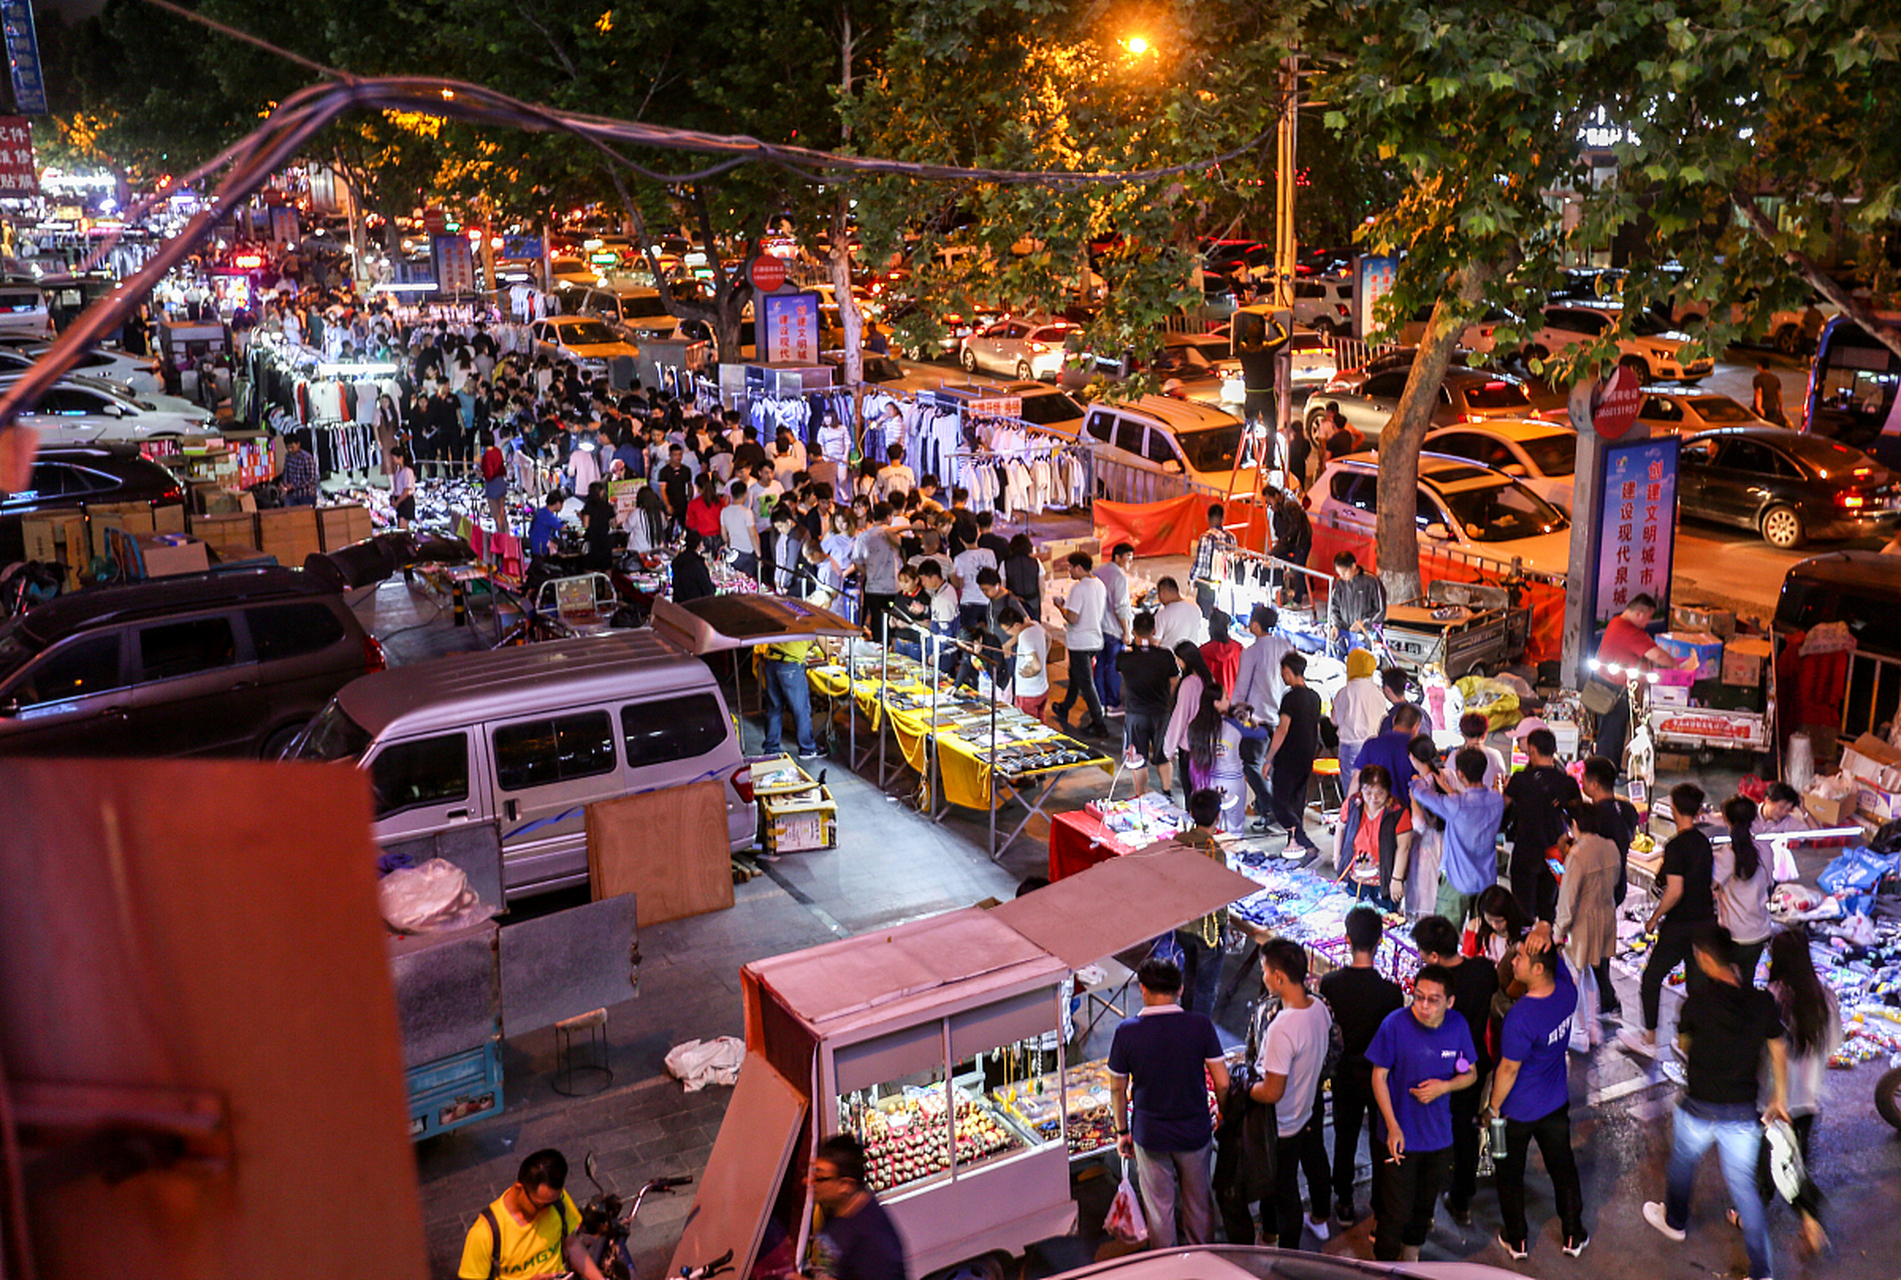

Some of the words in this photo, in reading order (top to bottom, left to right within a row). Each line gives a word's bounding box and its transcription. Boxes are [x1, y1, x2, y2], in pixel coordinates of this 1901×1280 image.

[778, 314, 790, 362] 建设现代
[1612, 481, 1636, 606] 建设现代泉城
[1640, 460, 1664, 586] 创建文明城市
